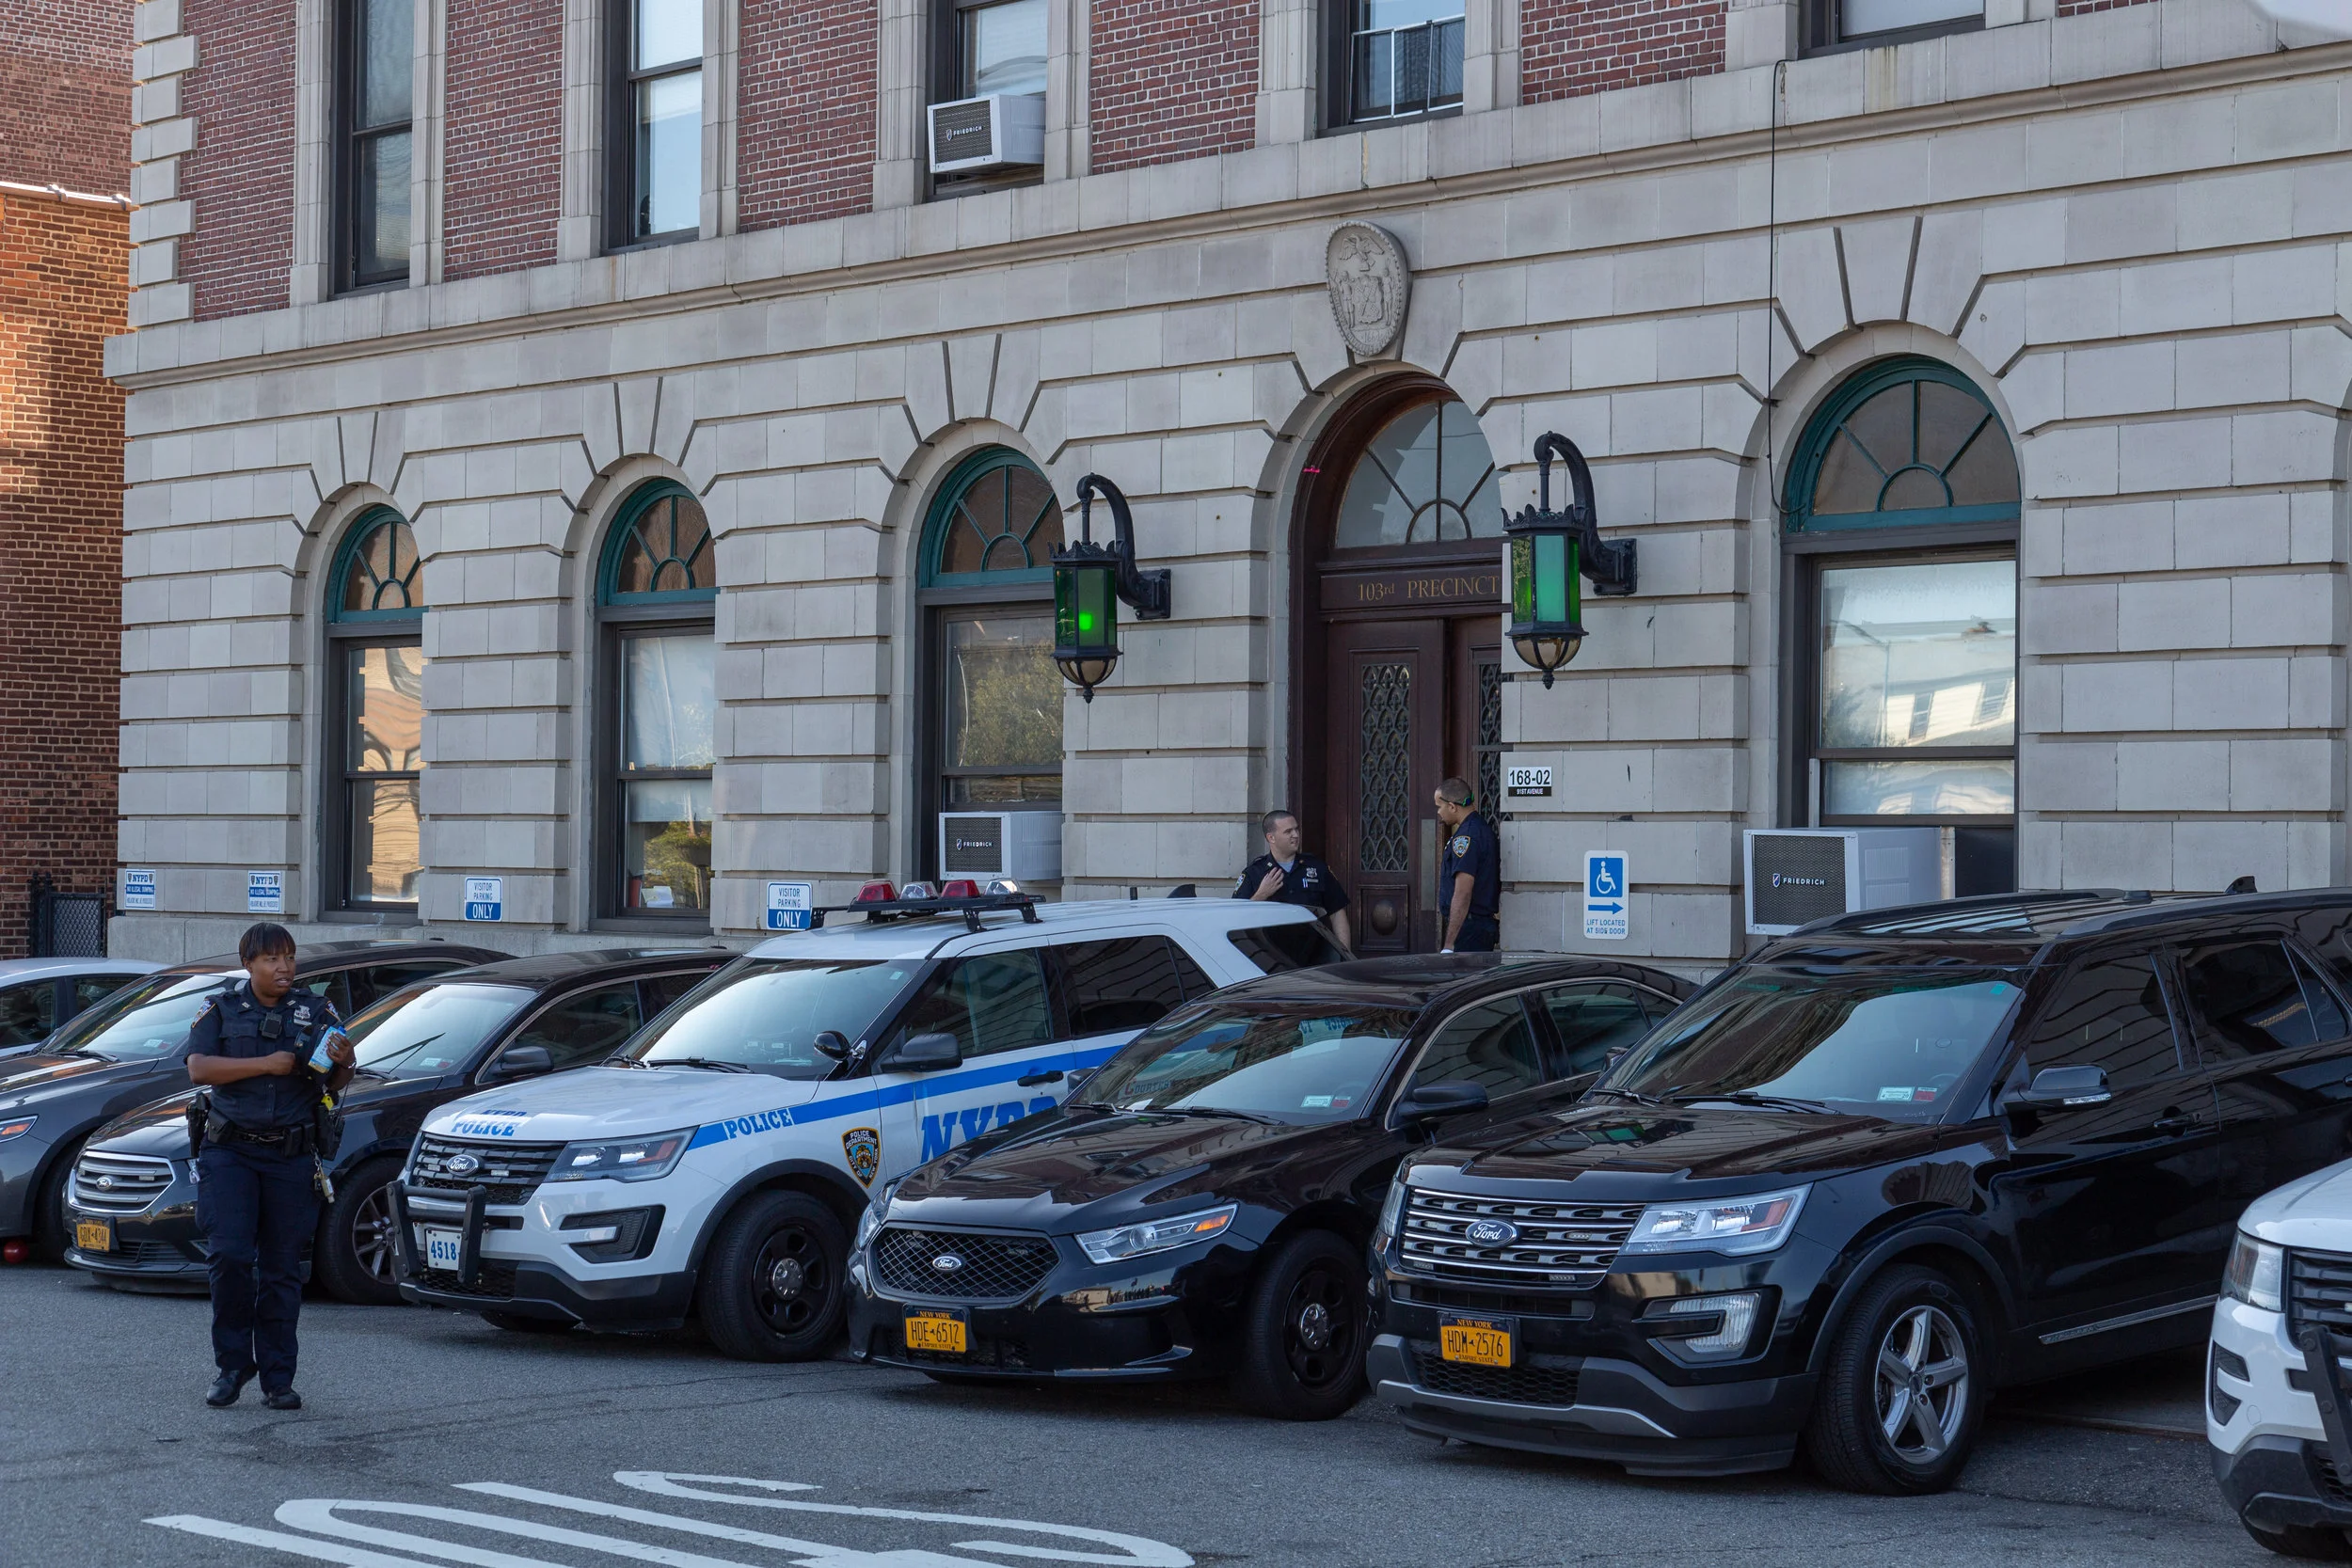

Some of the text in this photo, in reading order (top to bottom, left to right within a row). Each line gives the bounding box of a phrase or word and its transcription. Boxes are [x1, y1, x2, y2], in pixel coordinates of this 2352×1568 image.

[953, 125, 982, 135] FRIEDRICH
[1358, 575, 1500, 601] 103rd PRECINCT
[1509, 769, 1550, 785] 168-02
[132, 874, 149, 882] NYPD
[1783, 877, 1825, 885] FRIEDRICH
[473, 882, 493, 892] VISITOR
[778, 887, 801, 897] VISITOR
[473, 892, 493, 901] PARKING
[777, 898, 801, 909] PARKING
[472, 903, 494, 919] ONLY
[776, 911, 802, 928] ONLY
[451, 1119, 520, 1136] POLICE
[723, 1107, 793, 1140] POLICE
[850, 1130, 870, 1139] POLICE
[845, 1136, 878, 1149] DEPARTMENT
[430, 1240, 457, 1260] 4518
[934, 1311, 951, 1320] YORK
[1456, 1318, 1492, 1329] NEW YORK
